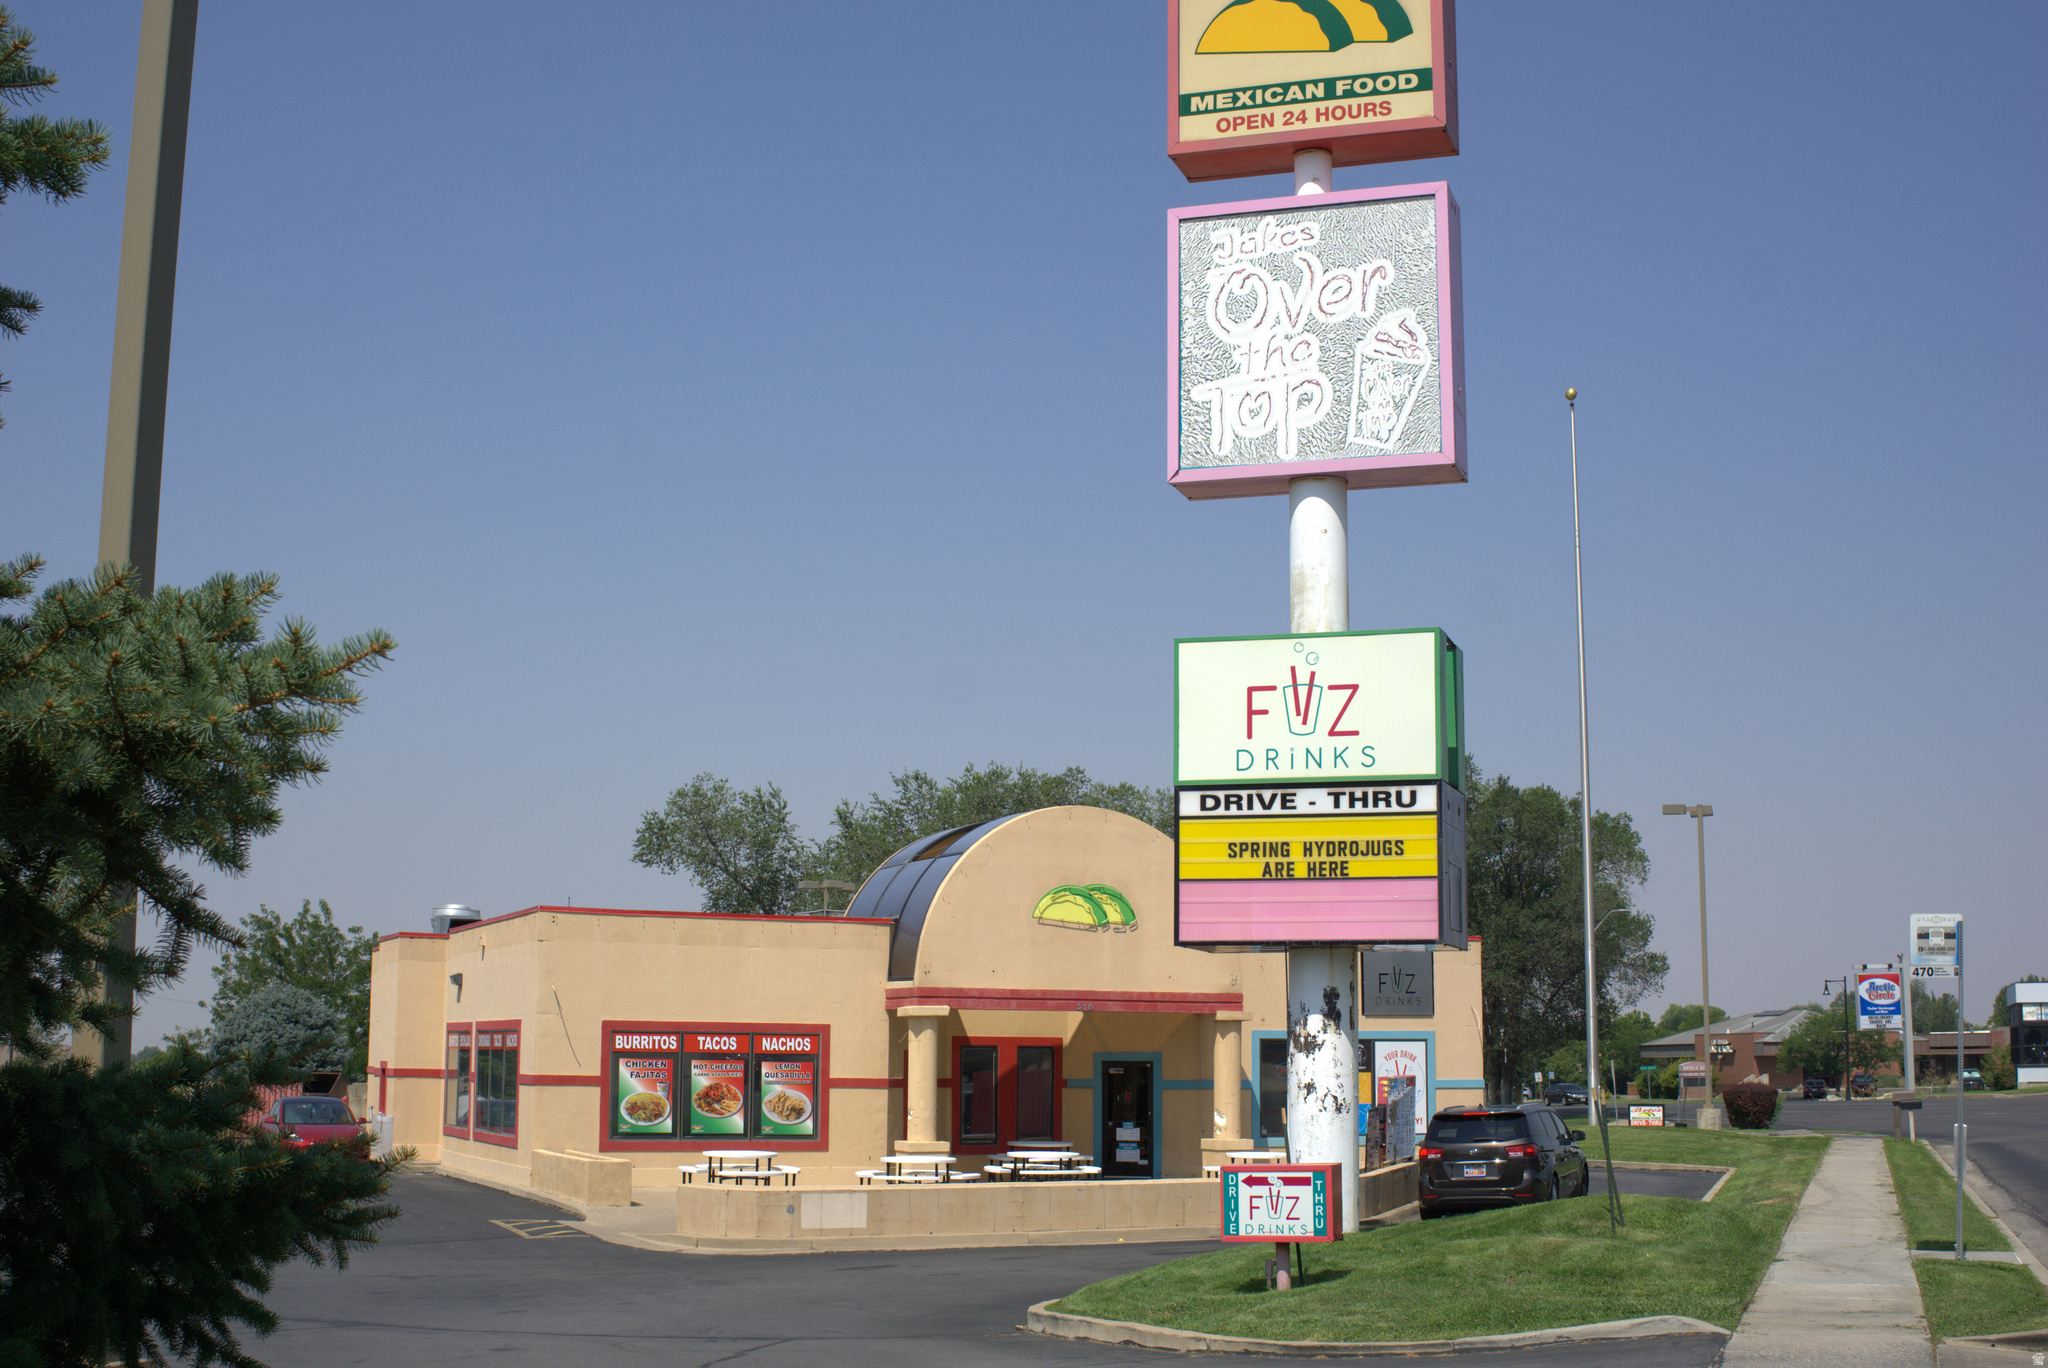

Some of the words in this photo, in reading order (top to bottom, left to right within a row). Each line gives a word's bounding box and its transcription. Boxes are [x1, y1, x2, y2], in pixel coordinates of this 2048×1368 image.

[1190, 81, 1325, 112] MEXICAN
[1335, 73, 1419, 97] FOOD
[1216, 112, 1275, 133] OPEN
[1282, 108, 1308, 126] 24
[1315, 100, 1392, 122] HOURS
[1206, 250, 1395, 346] Over
[1234, 330, 1321, 374] the
[1199, 792, 1297, 811] DRIVE
[1327, 789, 1418, 810] THRU
[1227, 841, 1291, 859] SPRING
[1303, 839, 1405, 857] HYDROJUGS
[1262, 861, 1295, 878] ARE
[1307, 860, 1350, 877] HERE
[1912, 966, 1934, 977] 470
[1865, 981, 1896, 994] Arctic
[1868, 990, 1896, 1001] Circle
[615, 1035, 677, 1049] BURRITOS
[697, 1036, 737, 1051] TACOS
[762, 1037, 811, 1051] NACHOS
[625, 1060, 667, 1068] CHICKEN
[1383, 1049, 1399, 1062] YOUR
[1400, 1049, 1418, 1063] DRINK
[630, 1071, 667, 1079] FAJITAS
[1228, 1174, 1237, 1234] DRIVE
[1315, 1180, 1324, 1229] THRU
